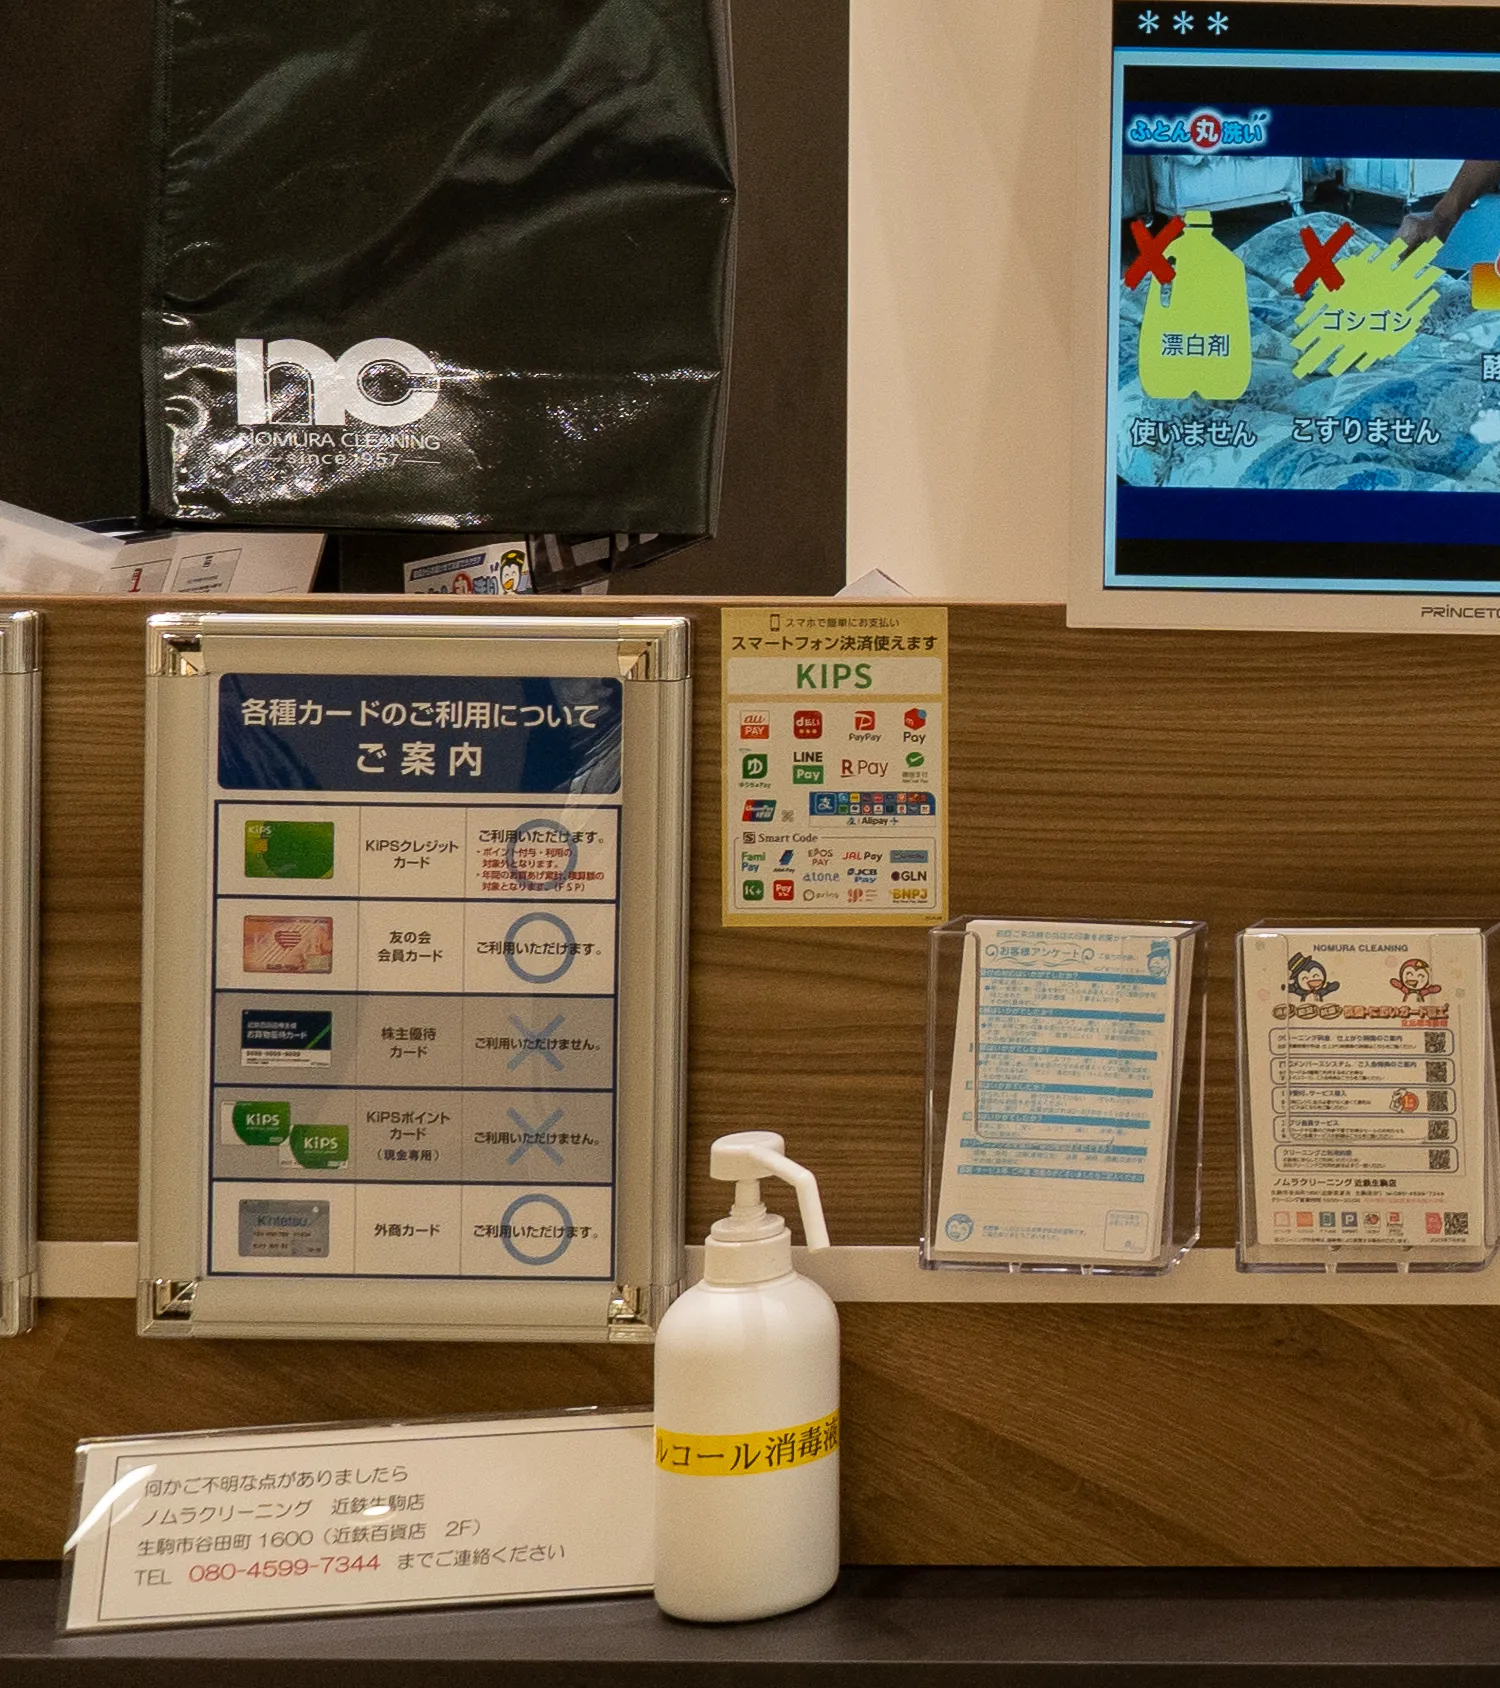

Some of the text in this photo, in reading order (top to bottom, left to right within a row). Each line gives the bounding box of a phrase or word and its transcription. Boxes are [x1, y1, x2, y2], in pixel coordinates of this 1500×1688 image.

[1322, 309, 1412, 334] ゴシゴシ
[1162, 333, 1230, 359] 漂白剤
[1131, 417, 1257, 448] 使いません
[1292, 416, 1440, 445] こすりません
[732, 635, 937, 651] スマートフォン決済使えます
[796, 663, 872, 689] KIPS
[241, 699, 600, 729] 各種カードのご利用について
[849, 732, 926, 743] PayPay Pay
[356, 742, 483, 776] ご案内
[793, 752, 823, 762] LINE
[389, 930, 432, 945] 友の会
[475, 940, 602, 956] ご利用いただけます。
[1313, 944, 1408, 952] NOMURA CLEANING
[377, 948, 443, 964] 会員カード
[381, 1026, 437, 1042] 株主優待
[374, 1222, 441, 1238] 外商カード
[144, 1465, 409, 1498] 何かご不明な点がありましたら
[141, 1499, 313, 1527] ノムラクリーニング
[137, 1534, 251, 1557] 生駒市谷田町
[134, 1544, 565, 1587] TEL 080-4599-7344 までご連絡ください
